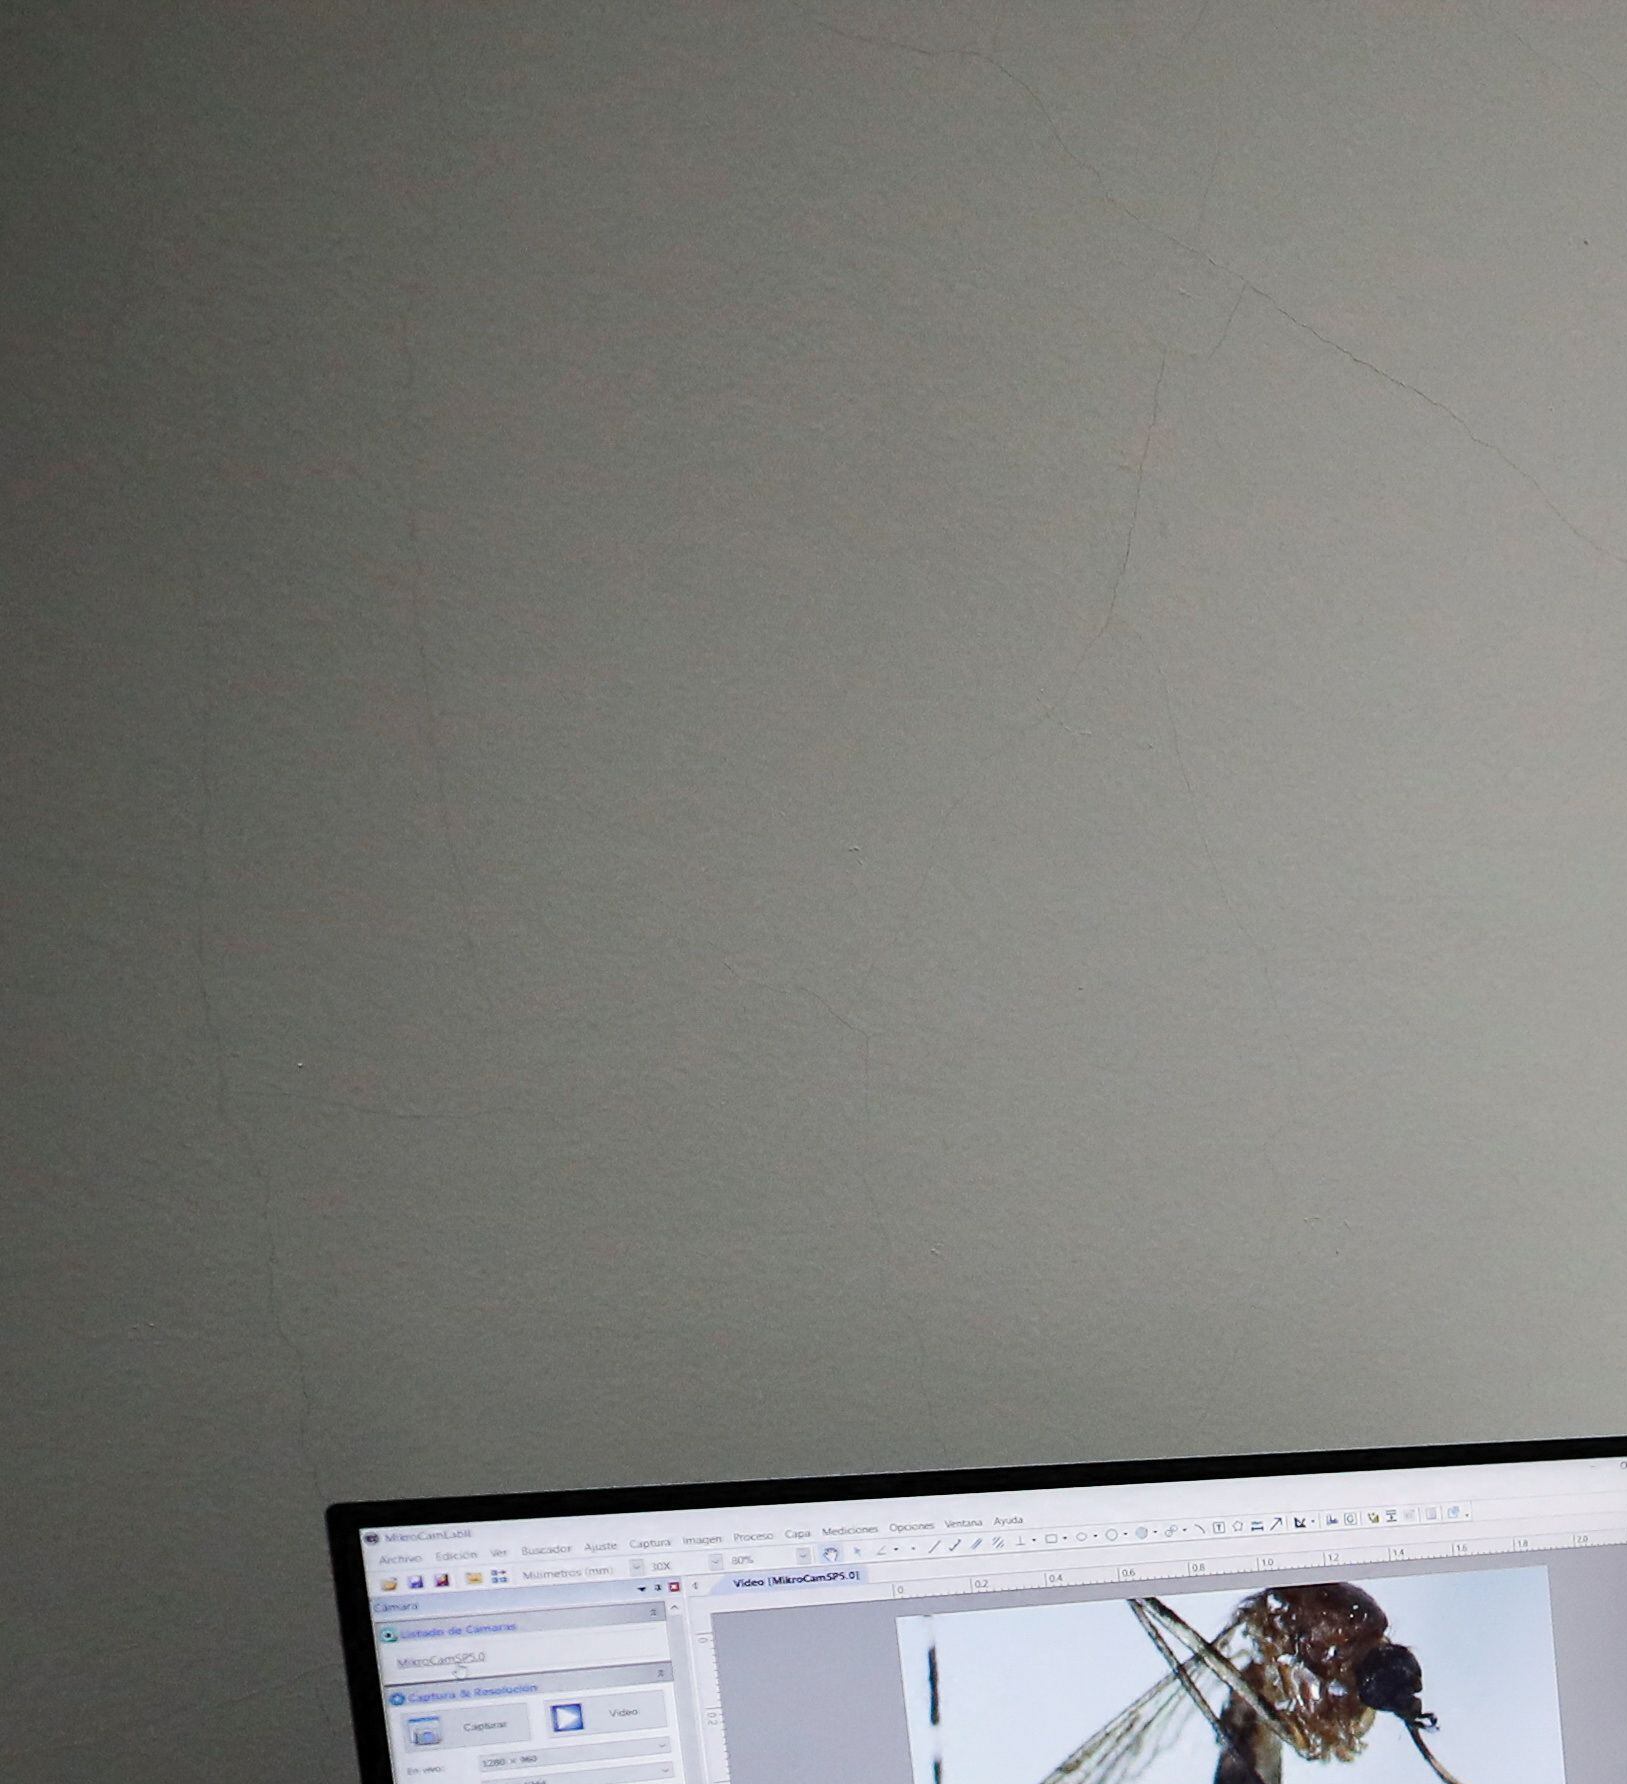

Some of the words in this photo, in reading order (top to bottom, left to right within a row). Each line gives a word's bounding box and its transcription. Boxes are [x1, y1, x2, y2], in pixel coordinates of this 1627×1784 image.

[379, 1553, 423, 1565] Archivo
[435, 1548, 478, 1561] Edición
[521, 1545, 571, 1556] Buscador
[583, 1541, 617, 1554] Ajuste
[629, 1538, 672, 1551] Captura
[682, 1534, 722, 1549] Imagen
[732, 1529, 774, 1543] Proceso
[785, 1527, 811, 1541] Capa
[822, 1523, 879, 1536] Mediciones
[889, 1519, 935, 1533] Opciones
[944, 1517, 982, 1529] Ventana
[993, 1514, 1023, 1527] Ayuda
[731, 1554, 754, 1565] 80%
[448, 1624, 462, 1636] de
[407, 1690, 457, 1705] Captura
[460, 1688, 471, 1699] &
[474, 1682, 538, 1697] Resolución
[463, 1720, 508, 1733] Capturar
